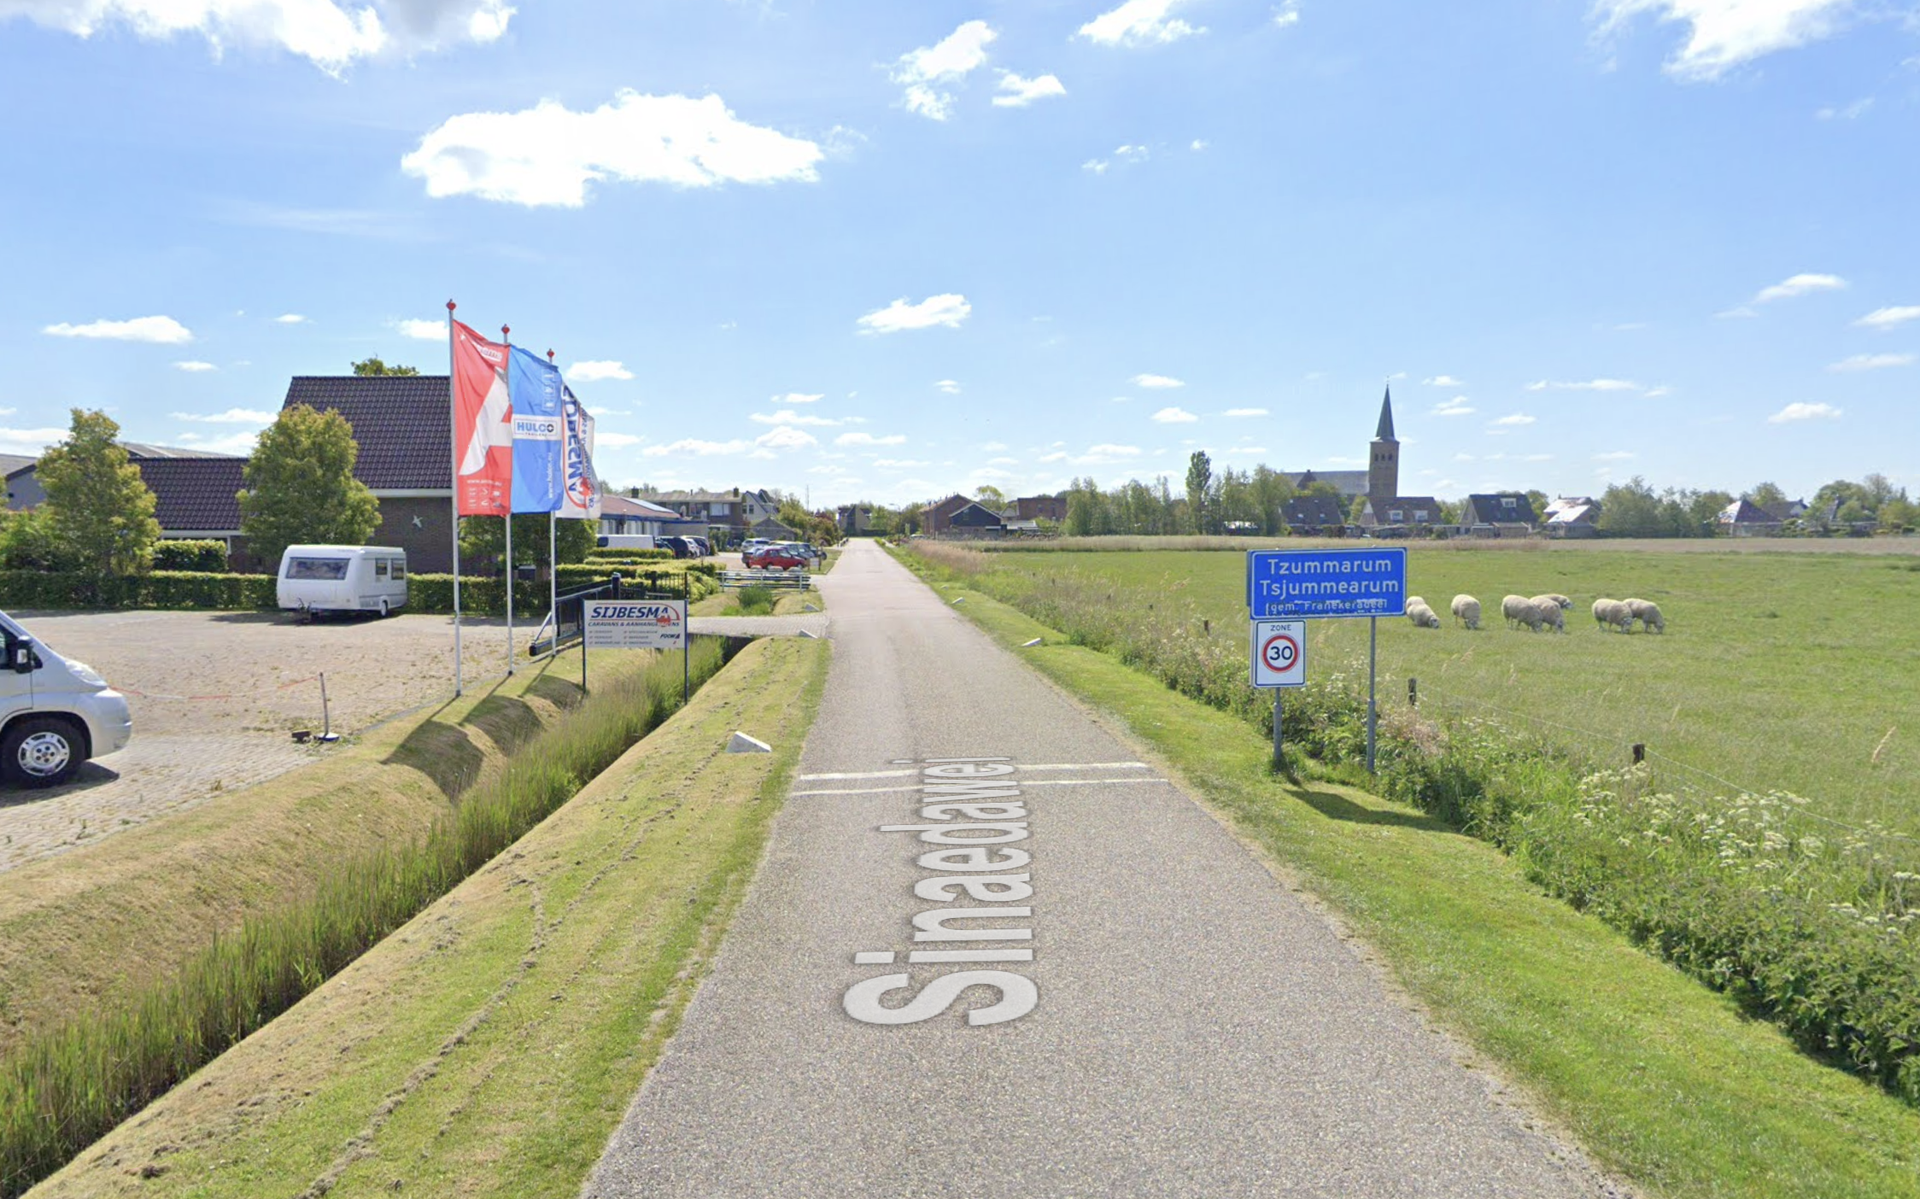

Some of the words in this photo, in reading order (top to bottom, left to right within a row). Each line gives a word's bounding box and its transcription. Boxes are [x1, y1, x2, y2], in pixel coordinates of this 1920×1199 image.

[517, 422, 554, 433] HULCO
[1267, 558, 1392, 575] Tzummarum
[1259, 579, 1399, 600] Tsjummearum
[591, 606, 671, 619] SIJBESMA
[1269, 646, 1293, 661] 30
